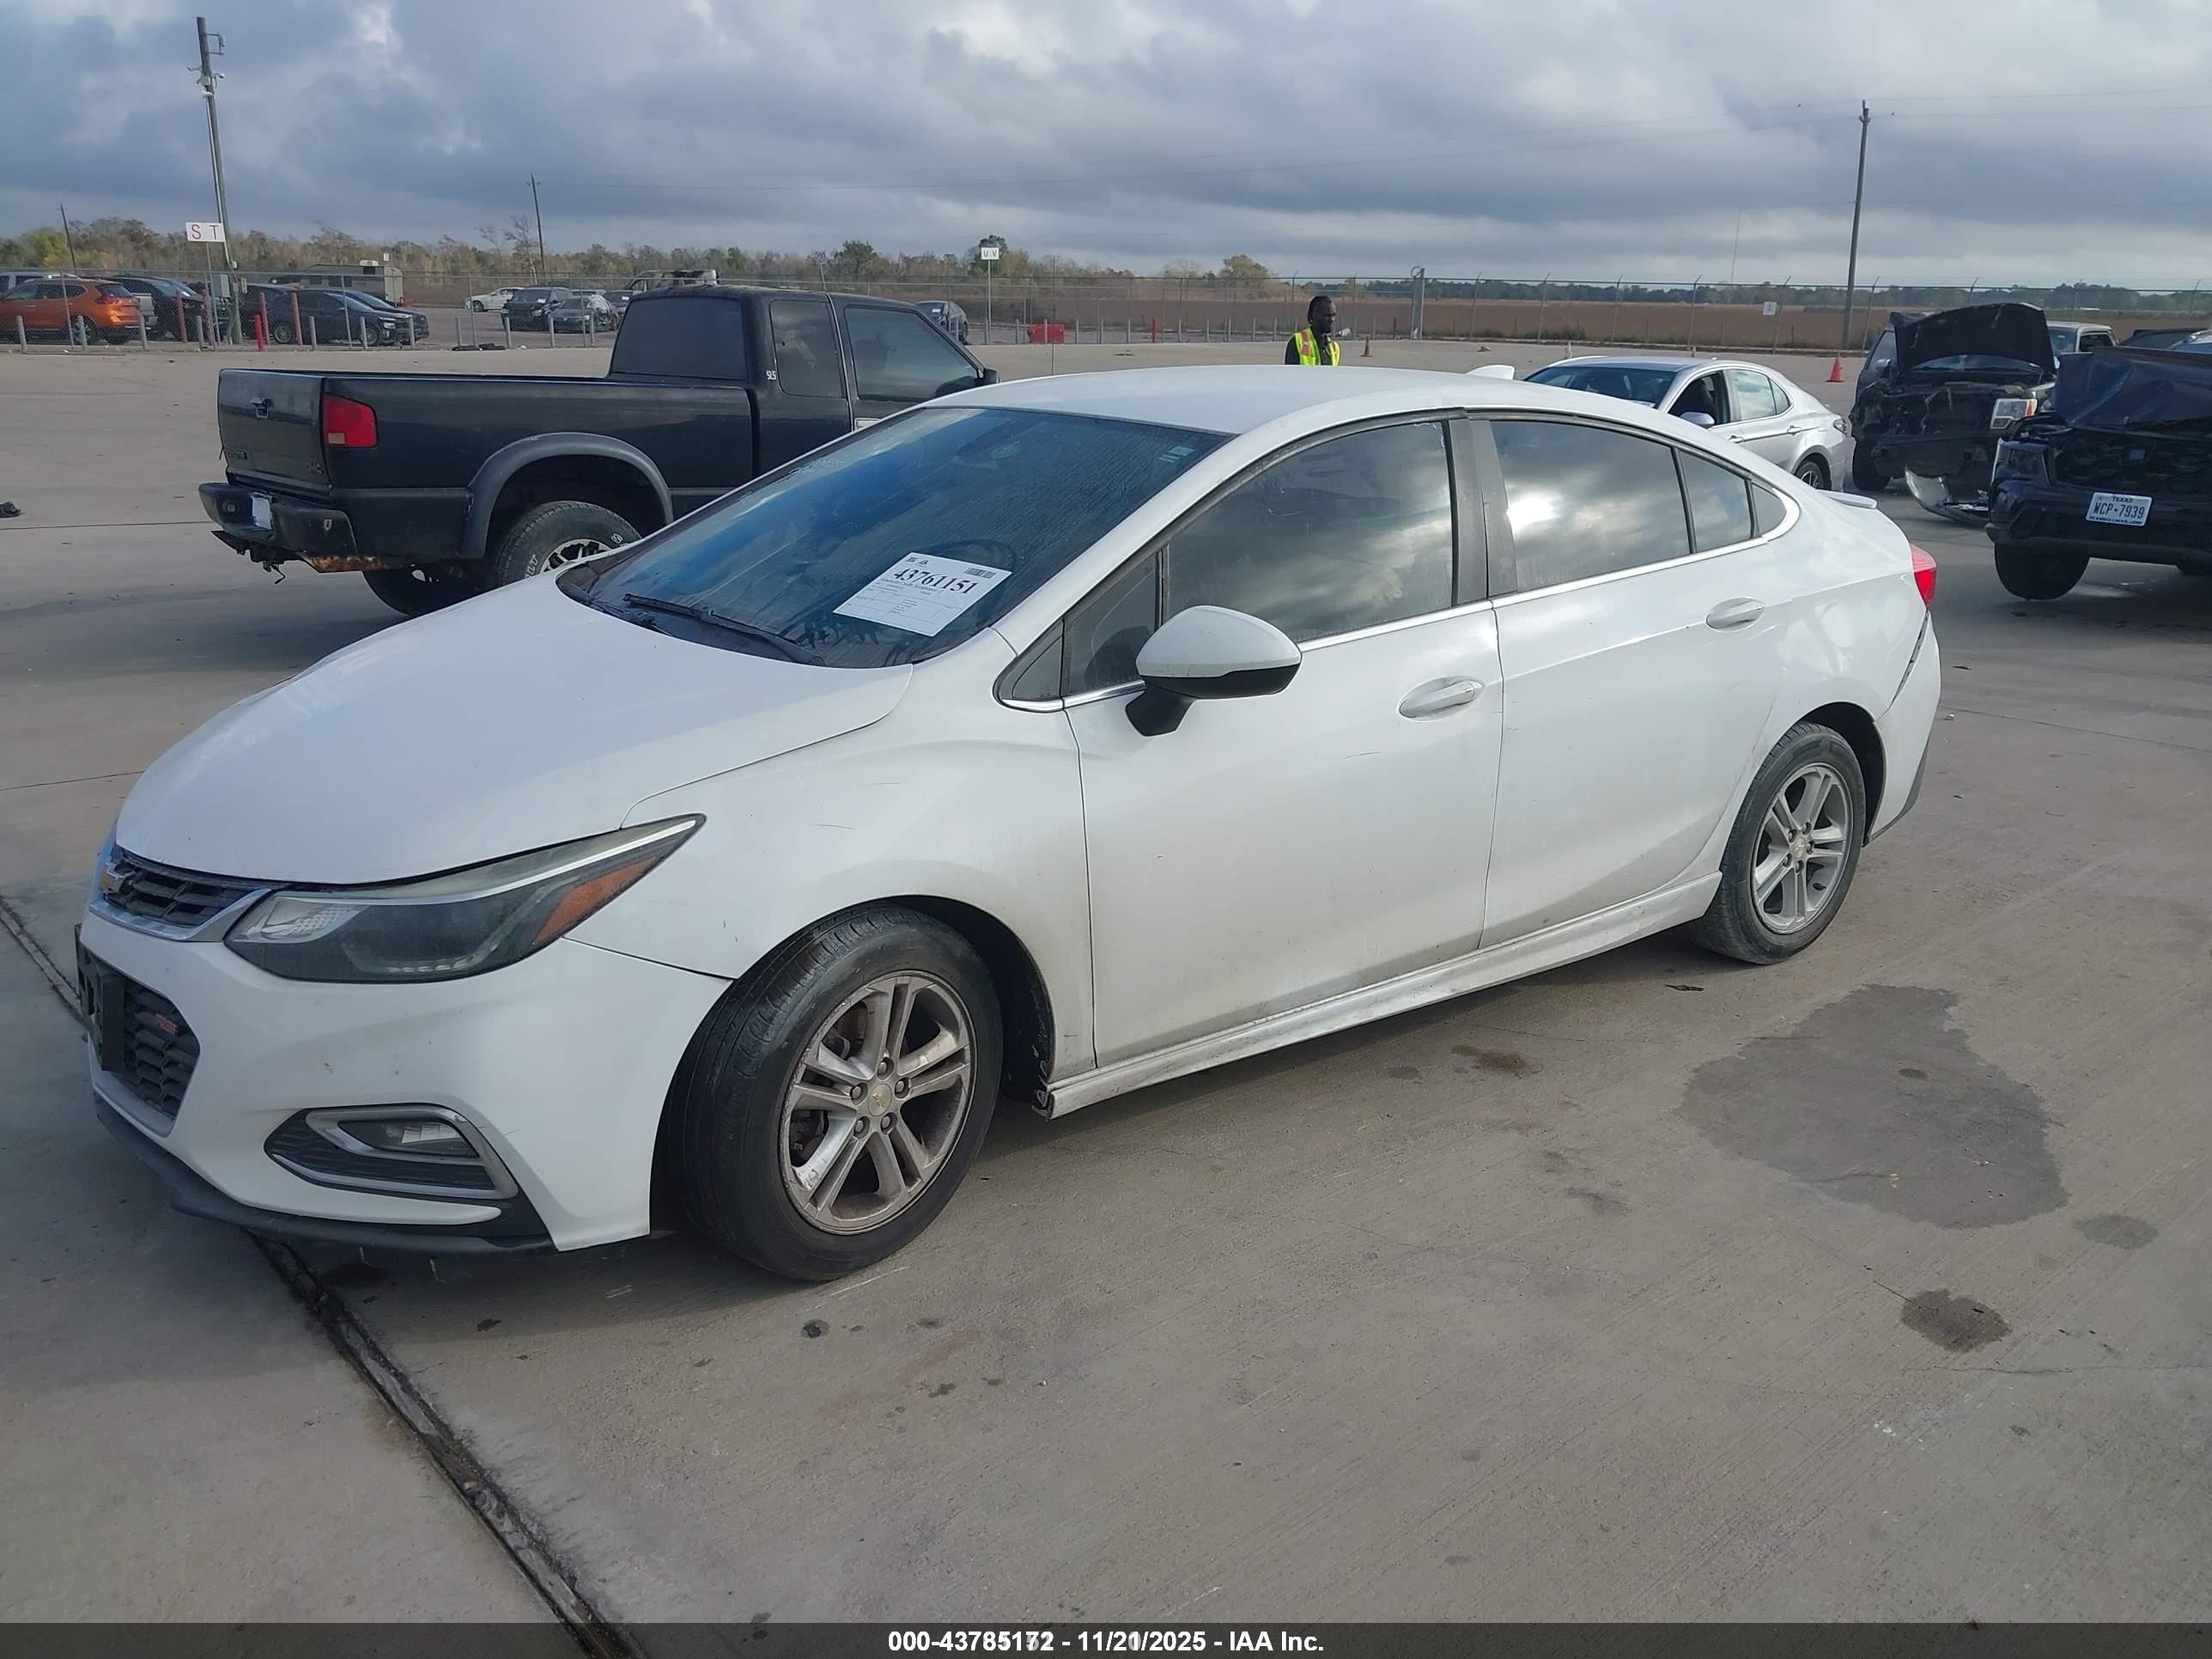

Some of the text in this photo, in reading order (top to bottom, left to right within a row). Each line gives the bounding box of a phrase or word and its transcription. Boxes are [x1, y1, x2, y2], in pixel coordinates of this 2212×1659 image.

[191, 224, 219, 240] S T
[894, 568, 979, 593] 43761151
